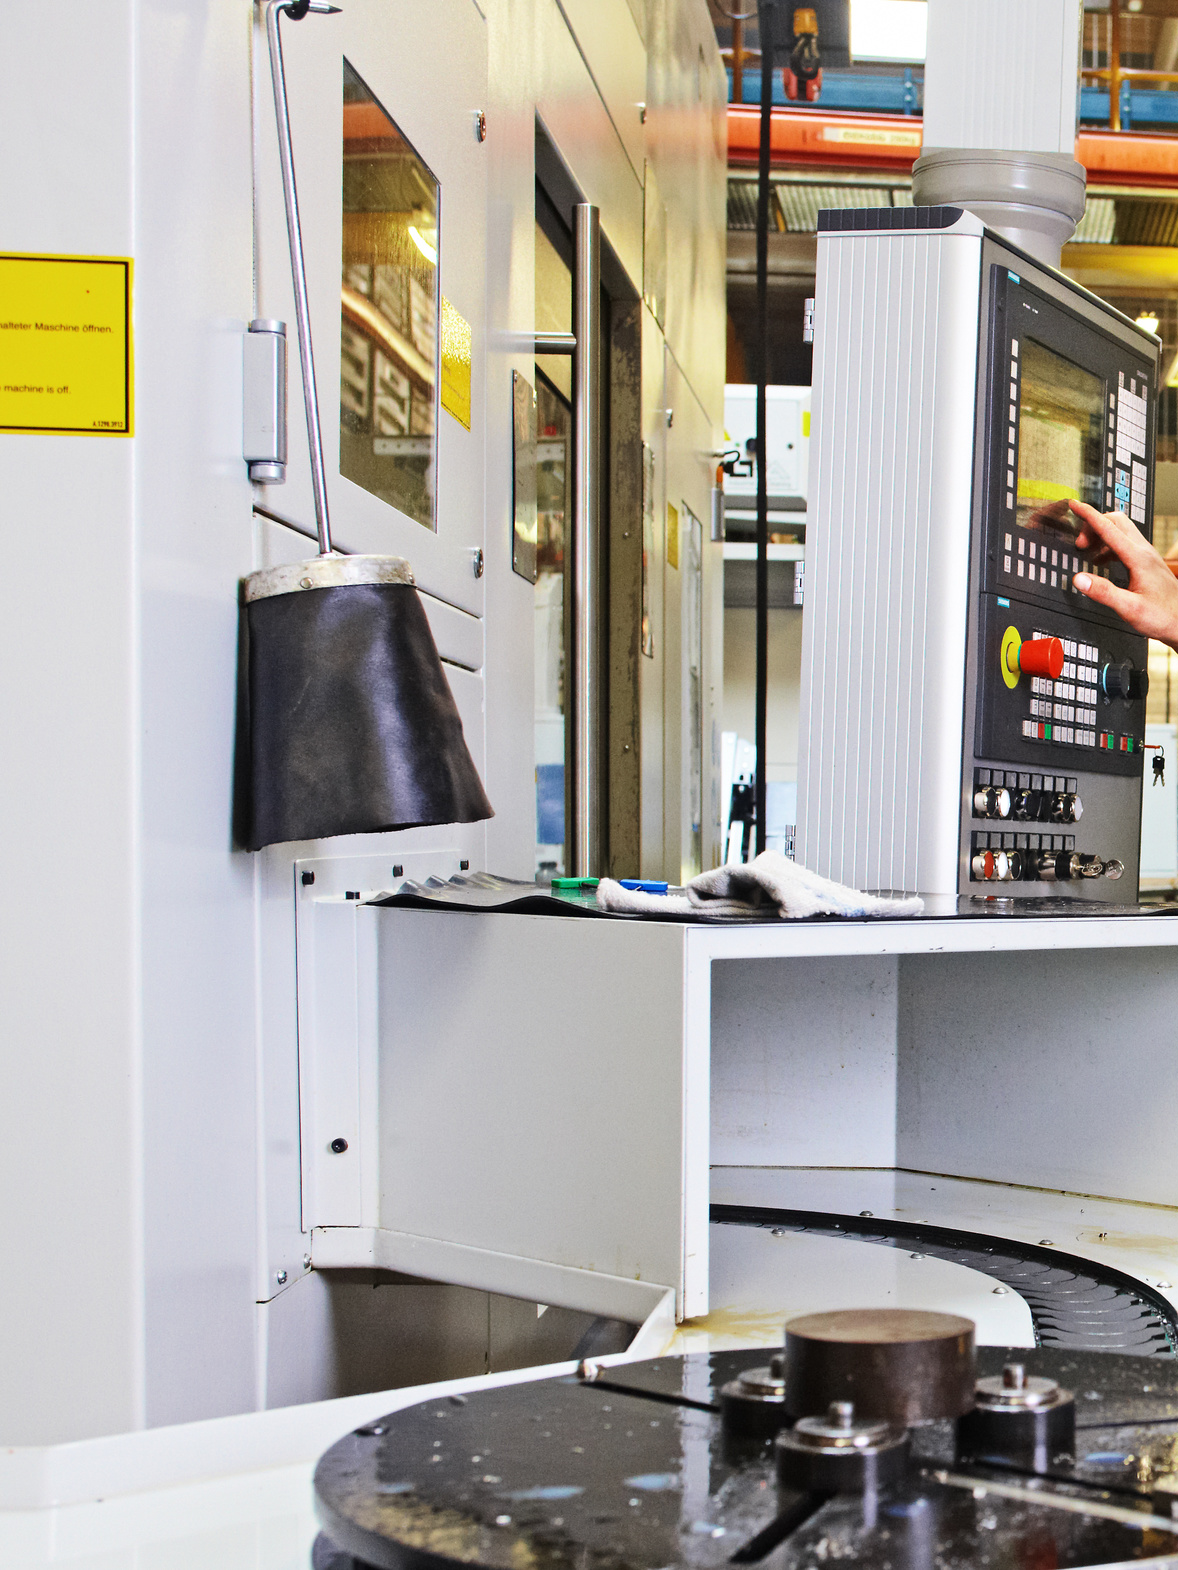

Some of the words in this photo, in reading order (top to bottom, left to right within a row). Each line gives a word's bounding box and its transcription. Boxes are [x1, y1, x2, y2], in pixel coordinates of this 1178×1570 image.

[35, 322, 80, 333] Maschine
[82, 324, 114, 334] öffnen.
[4, 384, 44, 394] machine
[47, 385, 54, 394] is
[57, 385, 71, 395] off.
